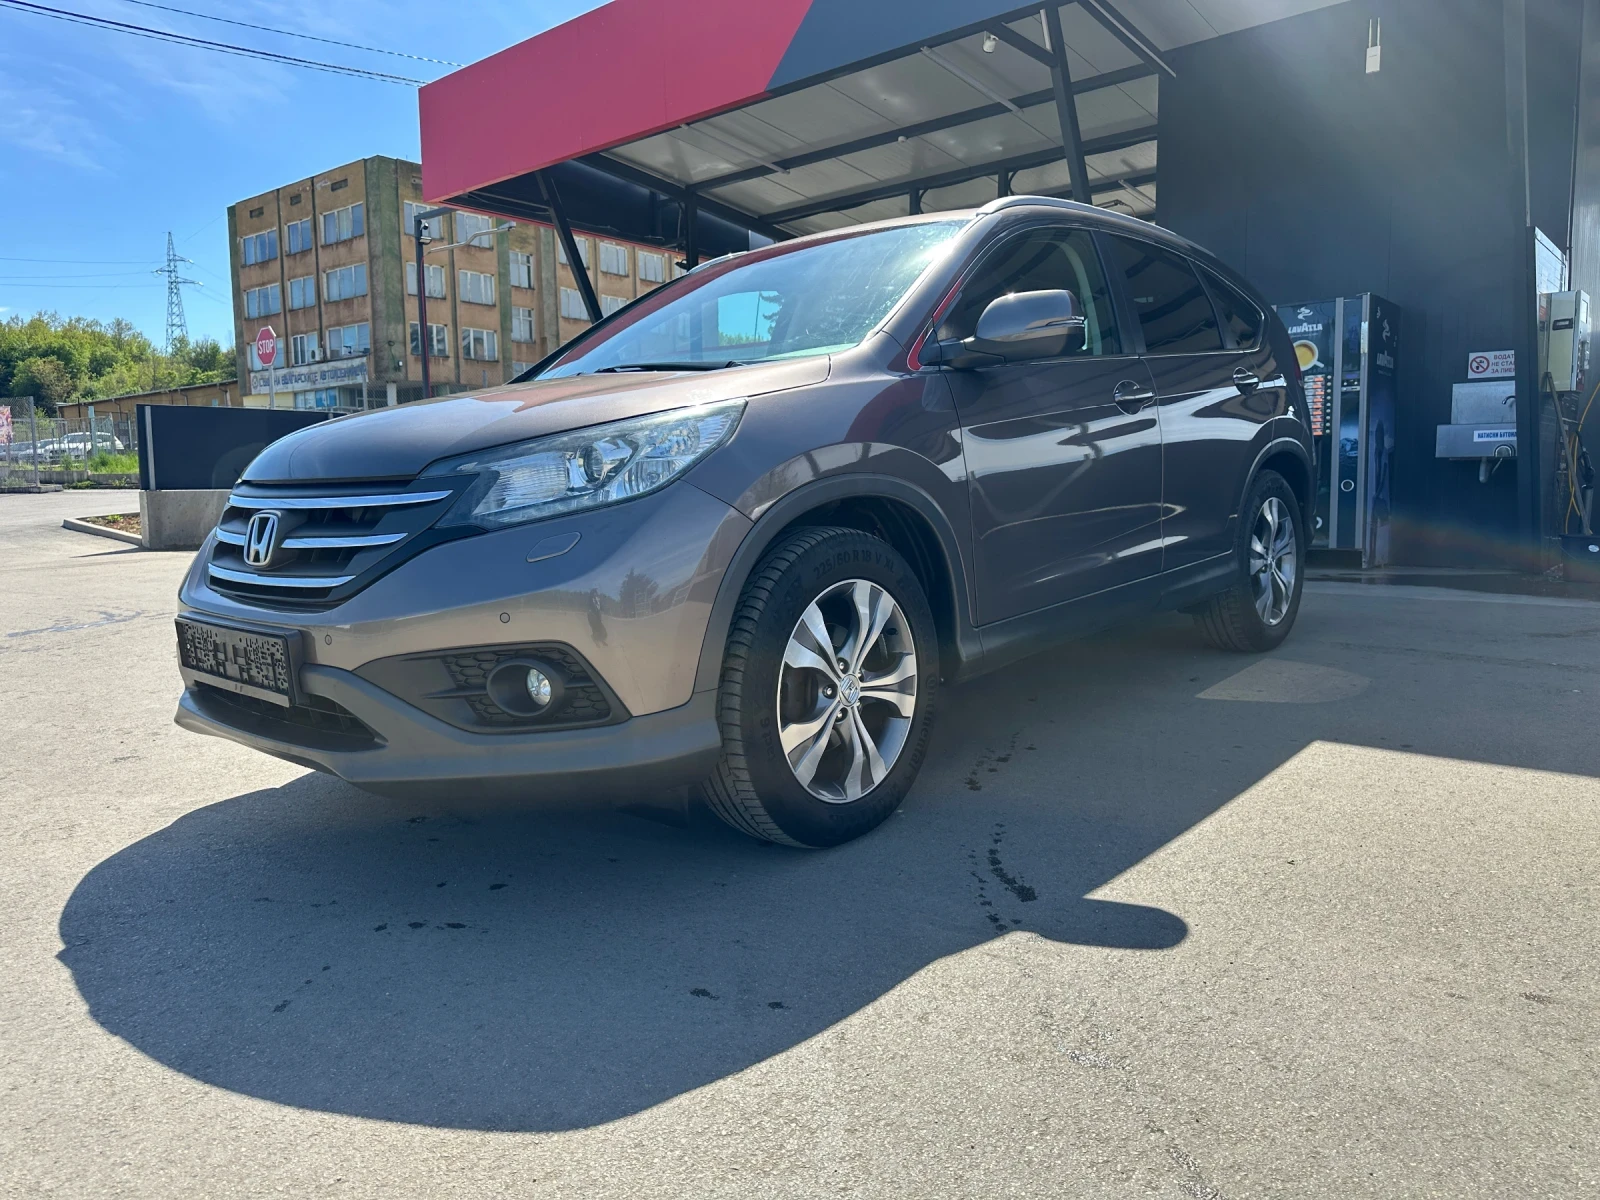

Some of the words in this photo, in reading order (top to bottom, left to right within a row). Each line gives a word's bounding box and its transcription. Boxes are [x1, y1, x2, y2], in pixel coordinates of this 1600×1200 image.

[1287, 322, 1323, 333] LAVAZZA
[258, 339, 274, 355] STOP
[813, 550, 850, 580] 225/60
[908, 674, 938, 773] Continental
